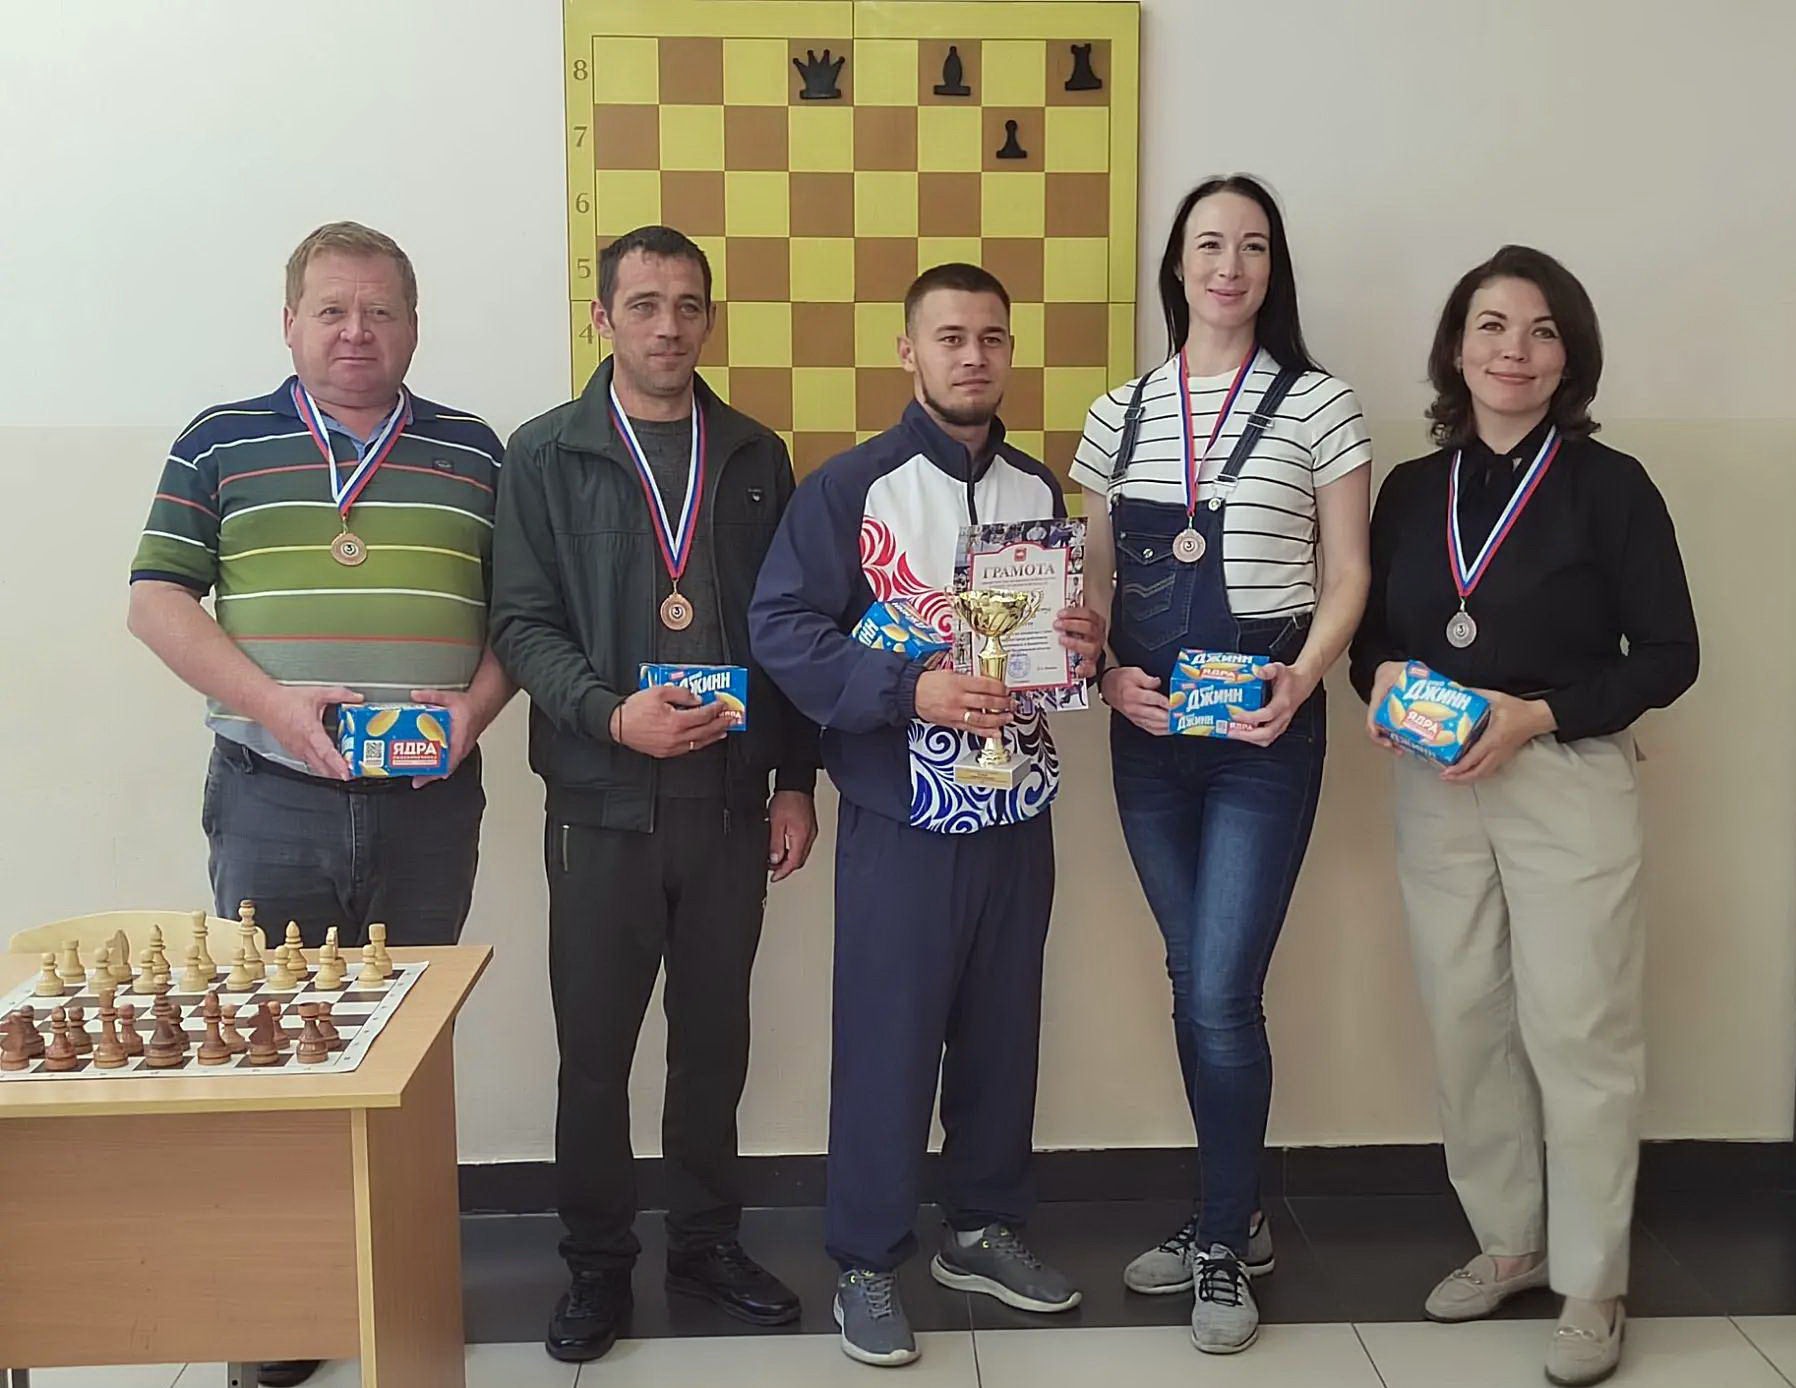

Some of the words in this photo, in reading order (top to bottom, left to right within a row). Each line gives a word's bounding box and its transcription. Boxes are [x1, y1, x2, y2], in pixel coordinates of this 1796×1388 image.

[573, 59, 588, 81] 8
[573, 126, 588, 148] 7
[575, 192, 590, 214] 6
[577, 258, 592, 279] 5
[578, 322, 594, 345] 4
[982, 562, 1056, 579] ГРАМОТА
[1186, 684, 1243, 713] ДЖИНН
[1407, 710, 1440, 734] ЯДРА
[393, 742, 437, 755] ЯДРА
